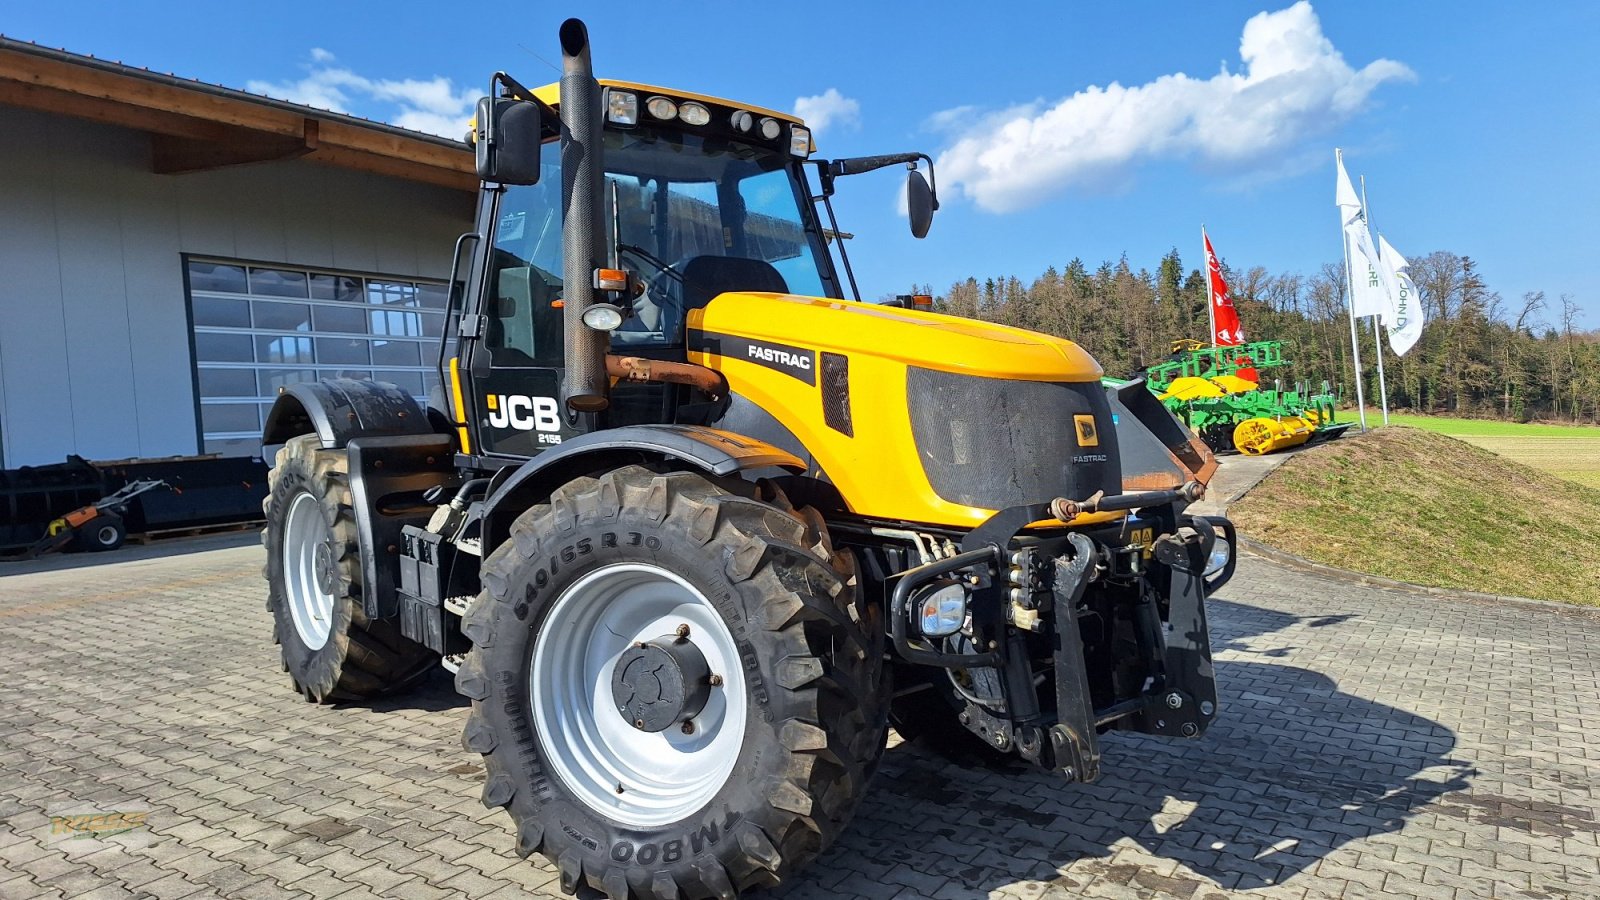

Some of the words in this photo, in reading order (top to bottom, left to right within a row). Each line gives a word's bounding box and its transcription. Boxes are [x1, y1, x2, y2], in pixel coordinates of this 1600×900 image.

[1398, 283, 1409, 315] JOHN
[748, 344, 811, 370] FASTRAC
[487, 394, 561, 432] JCB
[538, 433, 562, 445] 2155
[1073, 454, 1107, 464] FASTRAC
[601, 531, 618, 548] R
[626, 531, 662, 551] 30
